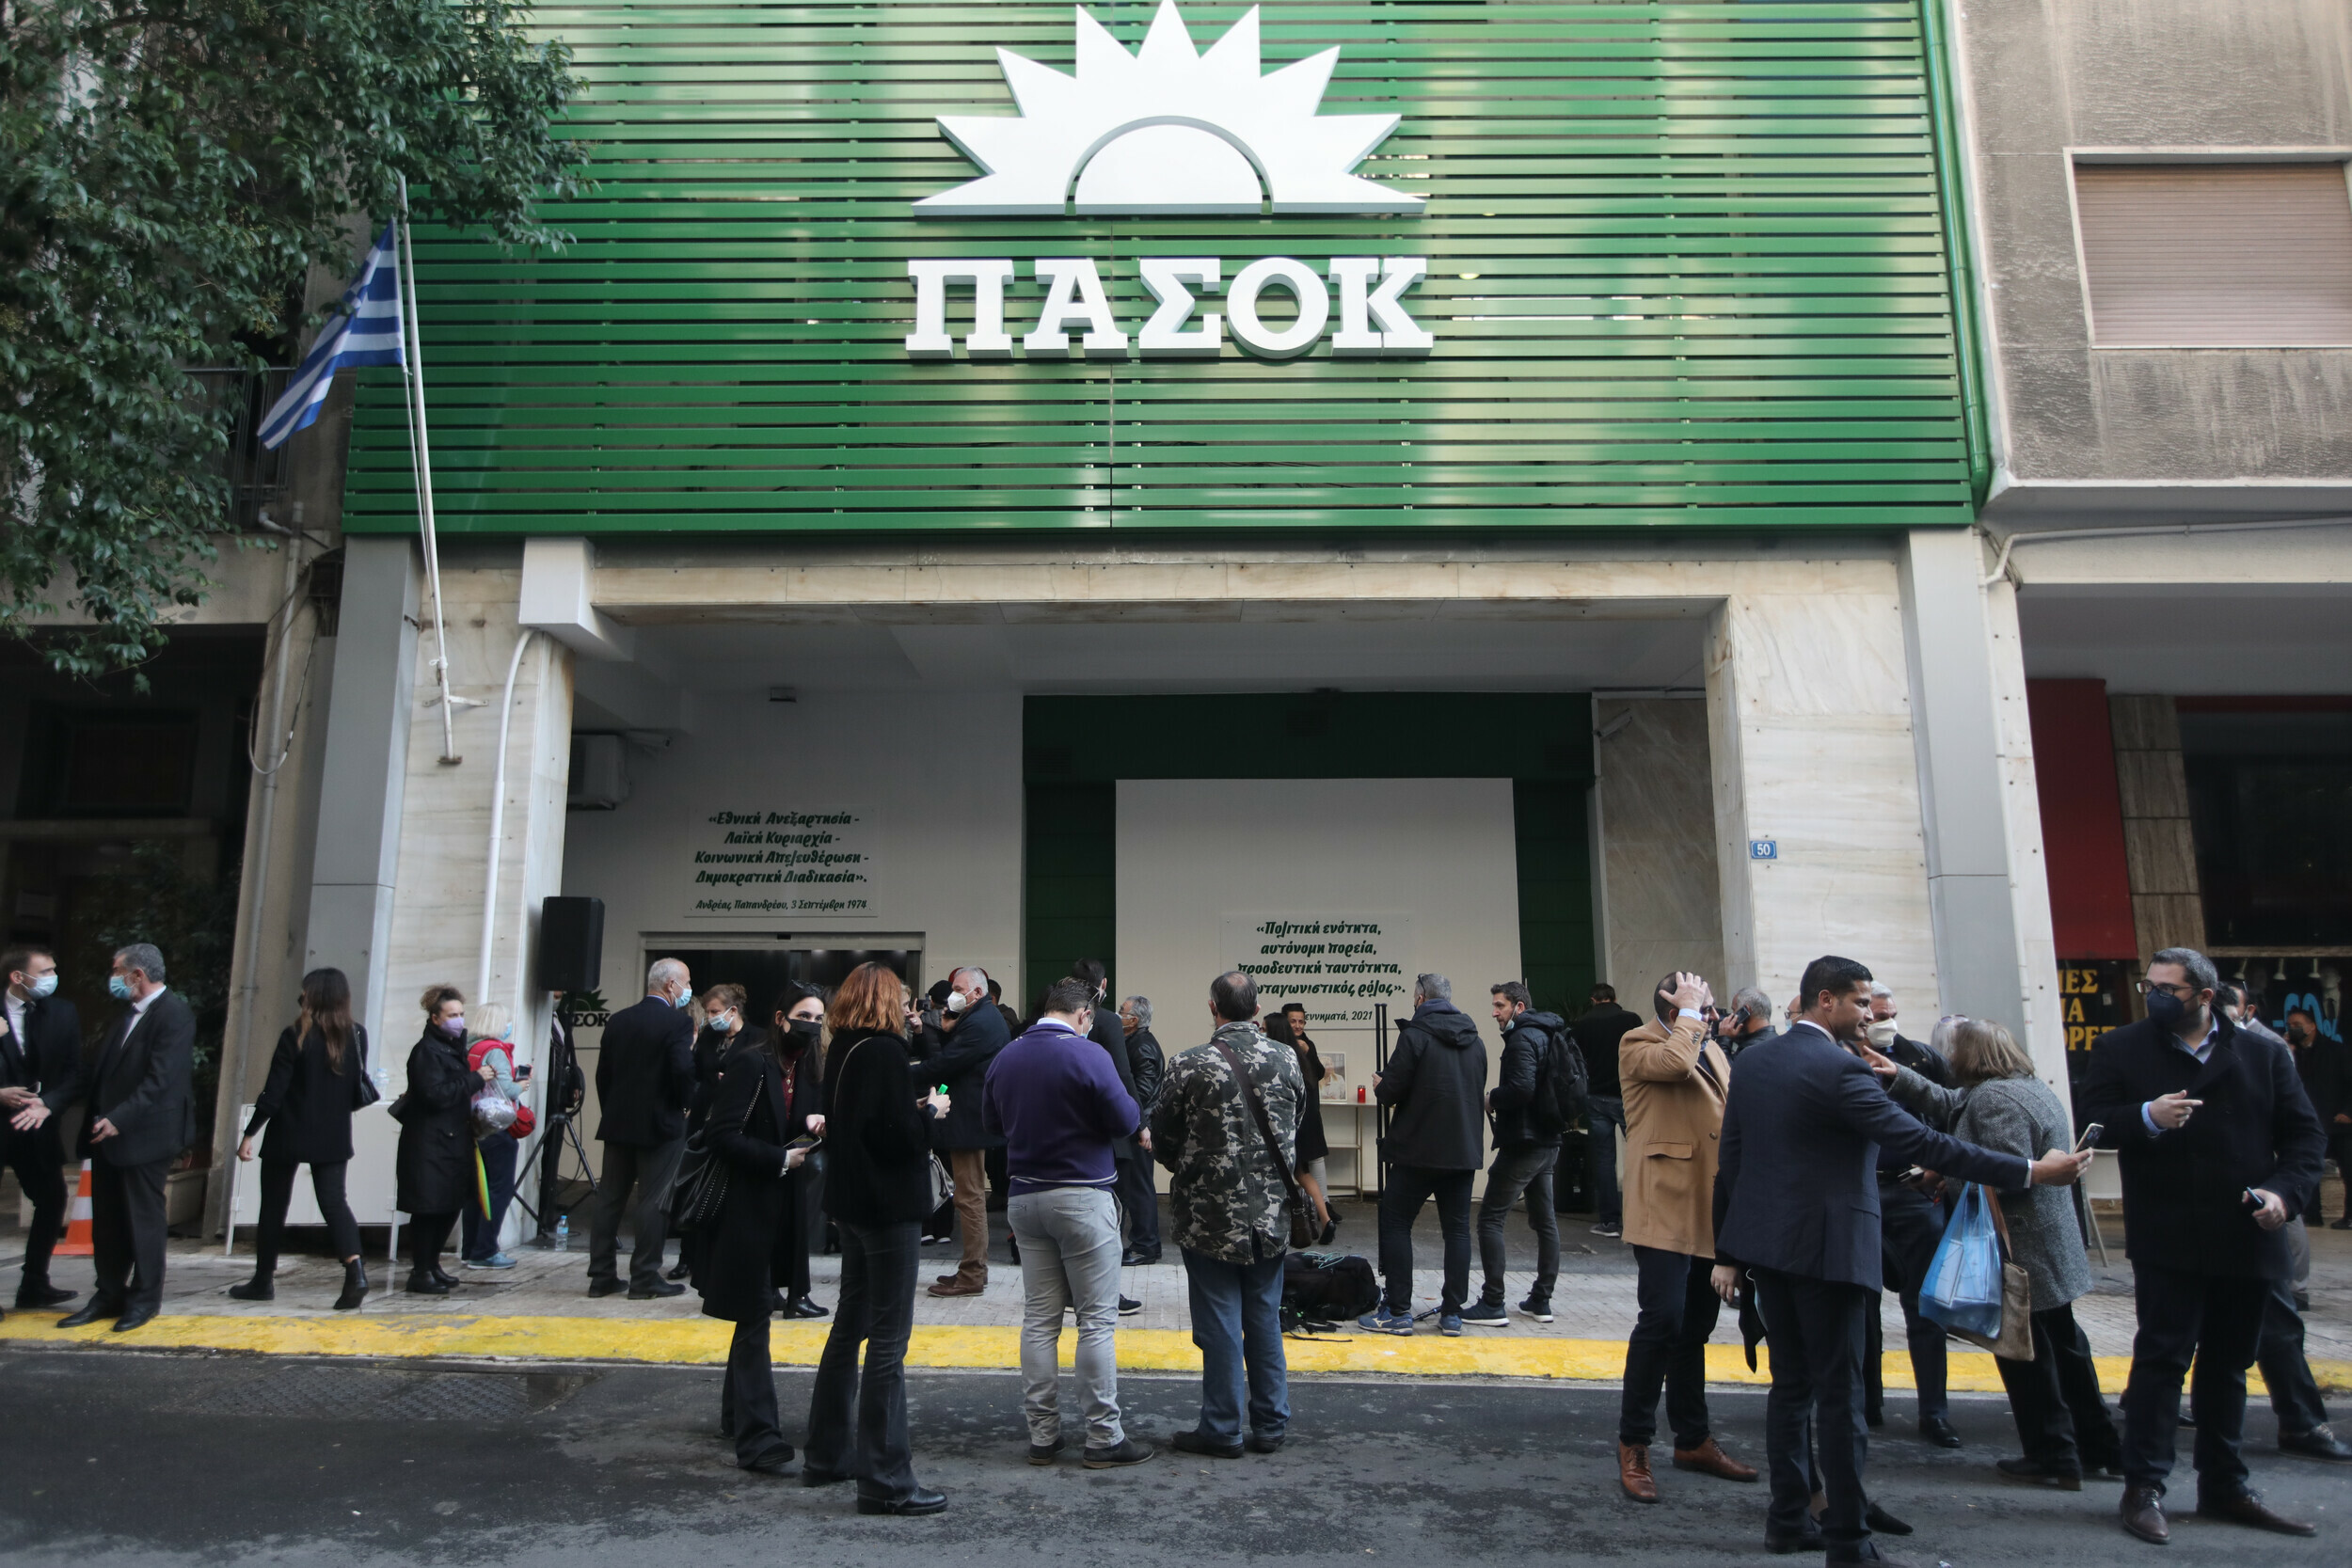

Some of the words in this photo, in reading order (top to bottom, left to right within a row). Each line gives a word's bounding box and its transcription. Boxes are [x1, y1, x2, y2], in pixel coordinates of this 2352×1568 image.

[905, 257, 1434, 359] ΠΑΣΟΚ
[708, 811, 761, 825] «Εθνική
[765, 811, 852, 829] Ανεξαρτησία
[723, 831, 764, 844] Λαϊκή
[765, 831, 833, 848] Κυριαρχία
[694, 850, 764, 863] Κοινωνική
[765, 849, 861, 867] Απελευθέρωση
[1756, 843, 1771, 856] 50
[695, 869, 783, 887] Δημοκρατική
[783, 869, 867, 883] Διαδικασία».
[695, 899, 733, 912] Ανδρέας
[734, 899, 788, 912] Παπανδρέου,
[790, 899, 798, 910] 3
[798, 899, 846, 912] Σεπτέμβρη
[847, 899, 867, 910] 1974
[1256, 921, 1320, 939] «Πολιτική
[1322, 921, 1382, 936] ενότητα,
[1260, 941, 1325, 958] αυτόνομη
[1327, 942, 1377, 958] πορεία,
[1325, 960, 1402, 975] ταυτότητα,
[1358, 980, 1406, 998] ρόλος».
[1351, 1010, 1373, 1022] 2021
